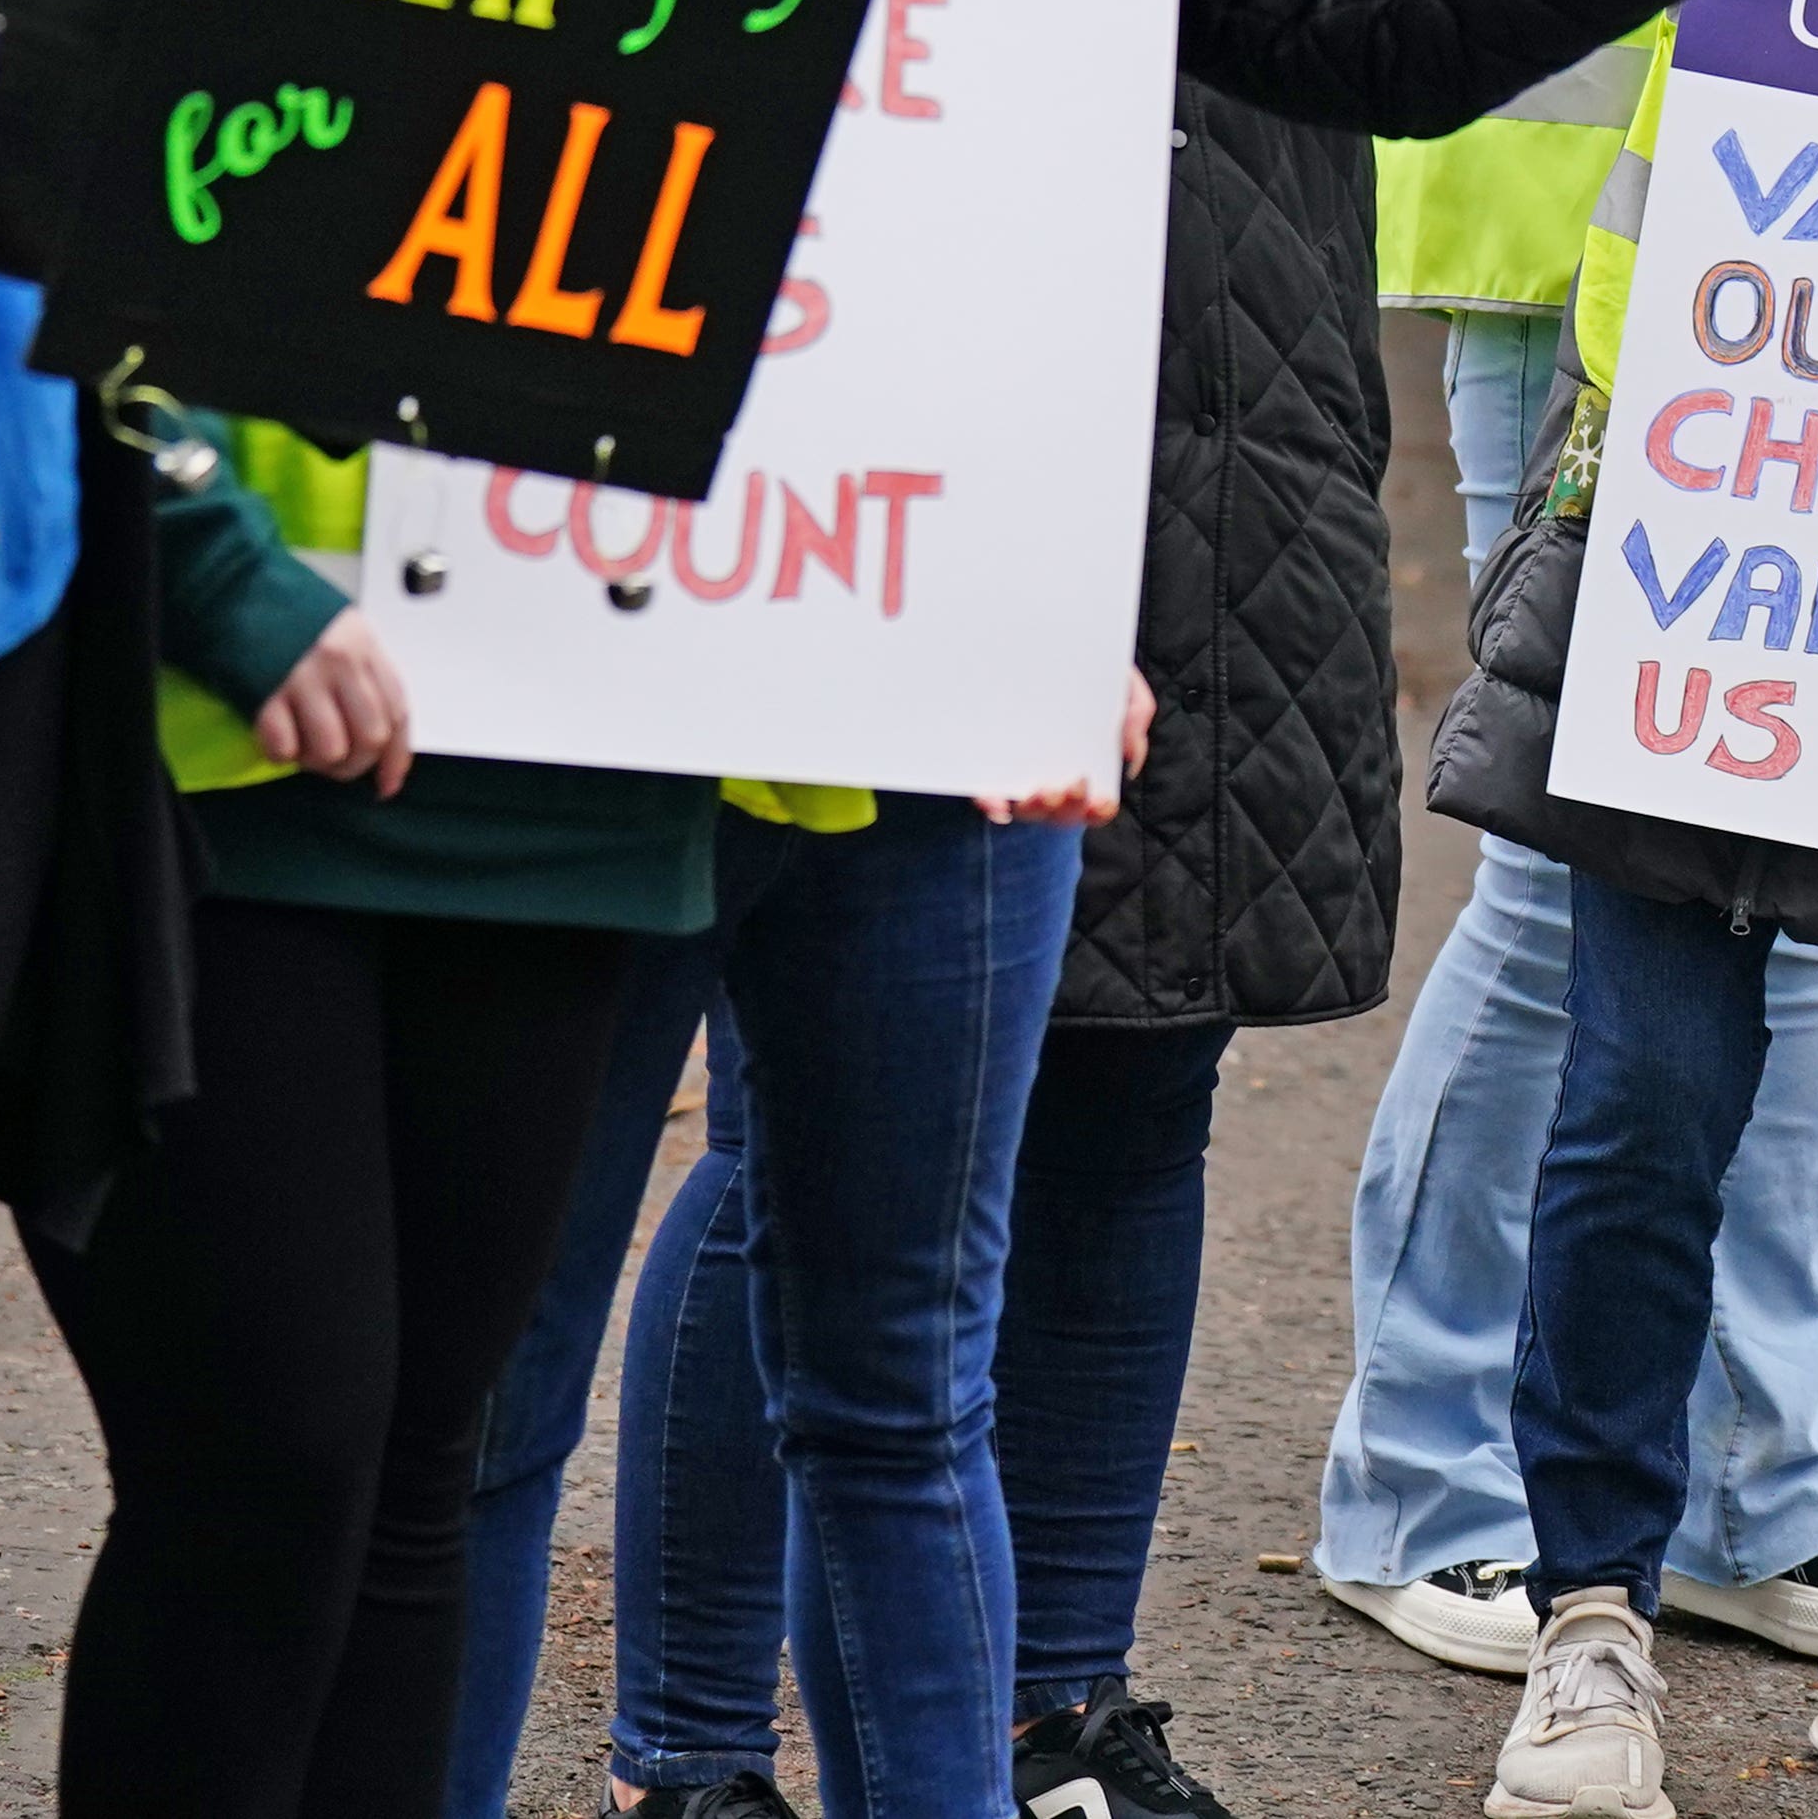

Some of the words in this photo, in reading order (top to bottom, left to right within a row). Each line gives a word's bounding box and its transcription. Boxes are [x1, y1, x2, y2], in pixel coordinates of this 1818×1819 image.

[162, 81, 355, 245] for
[365, 80, 717, 358] ALL
[486, 466, 945, 618] COUNT
[1633, 659, 1803, 782] US
